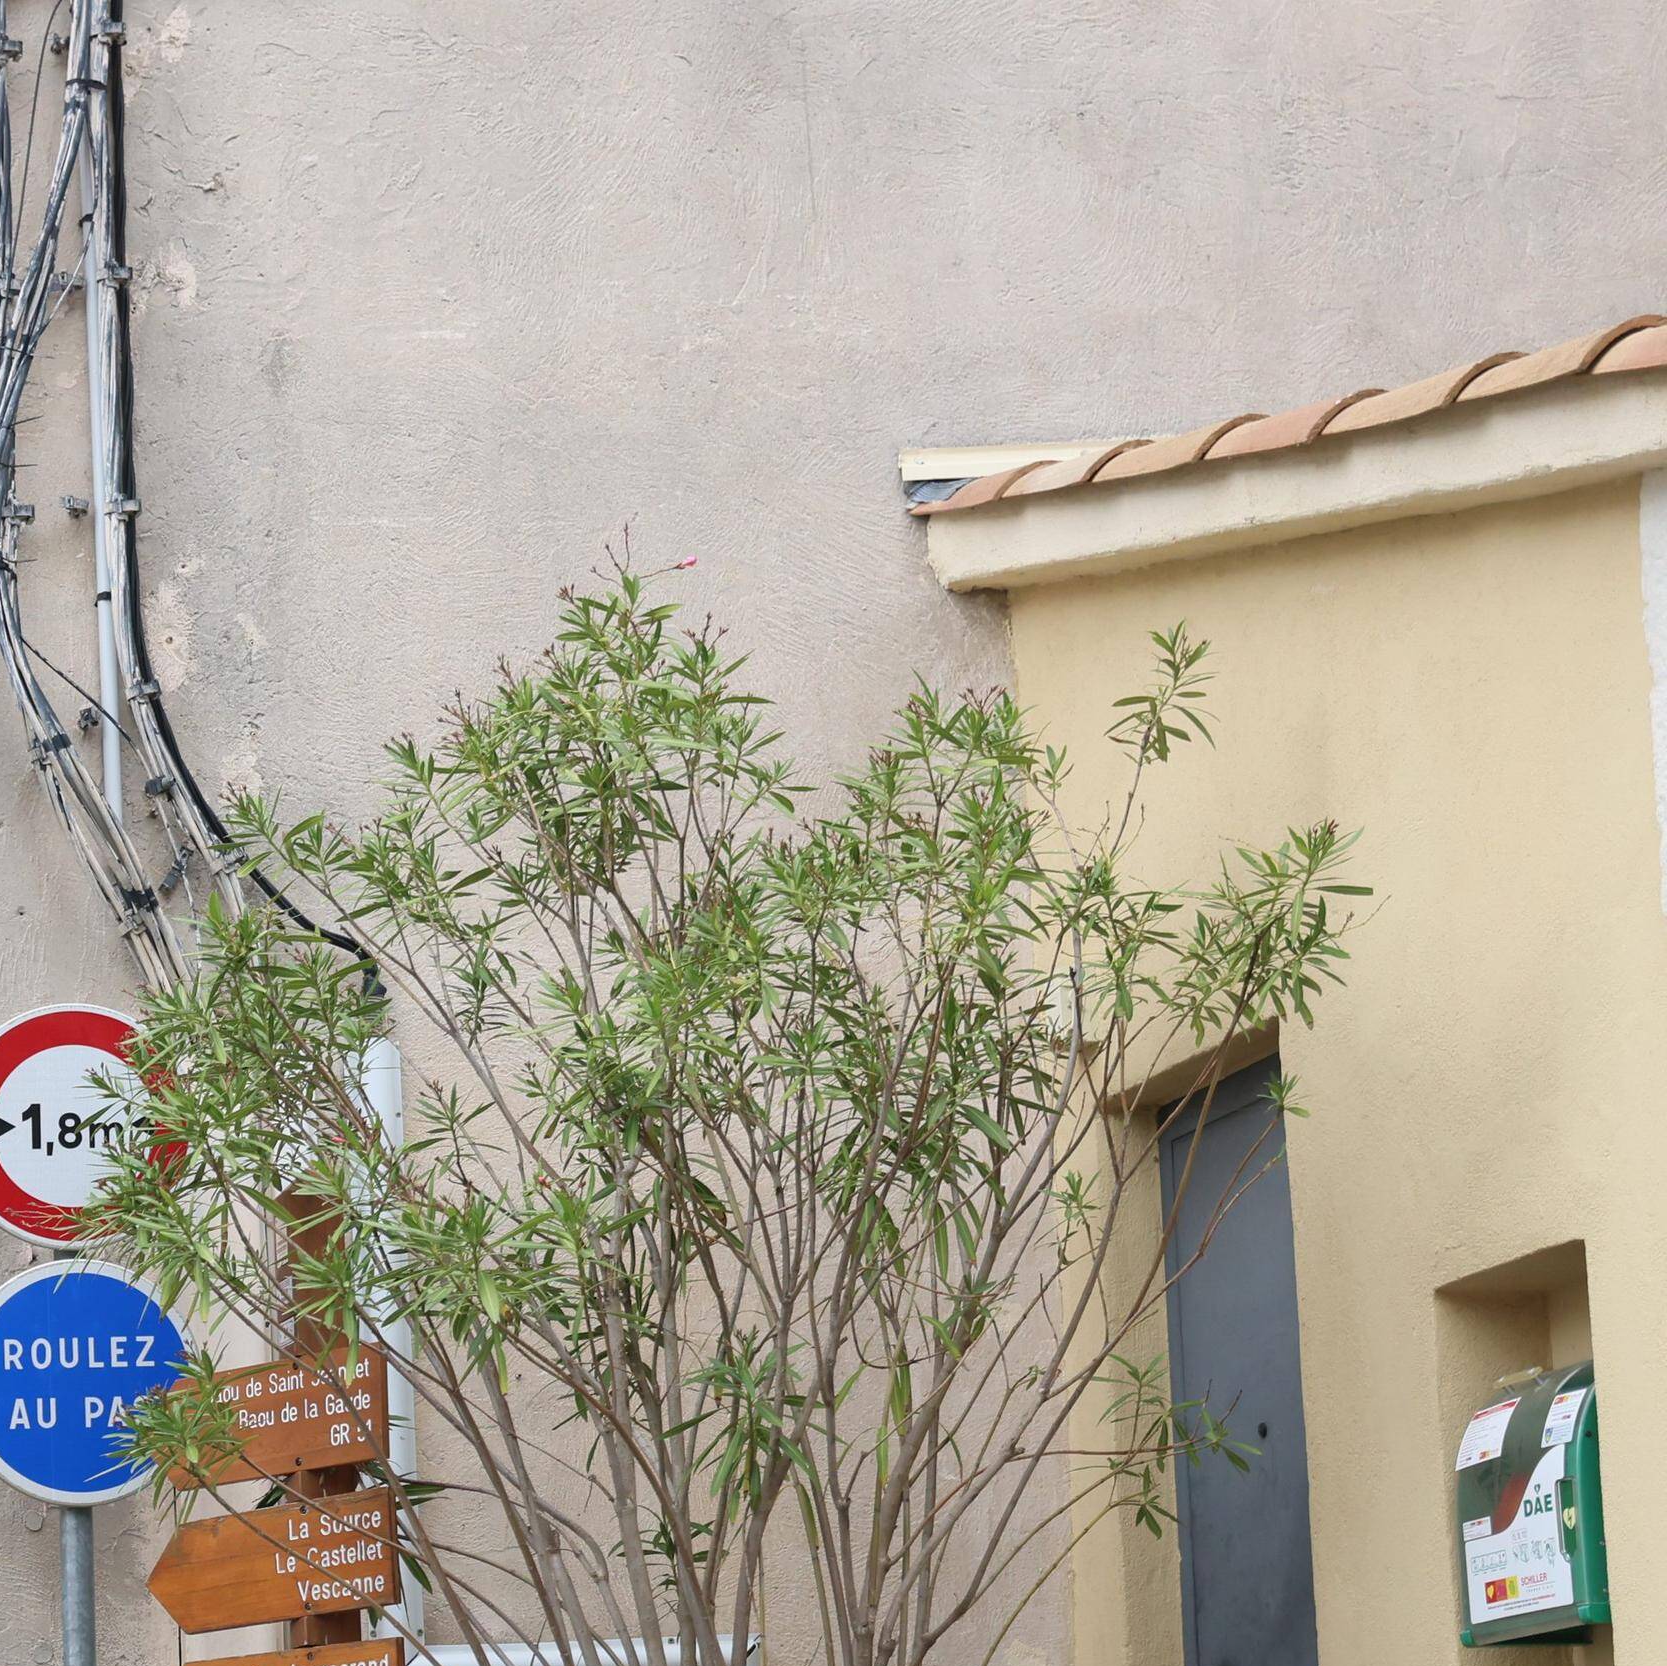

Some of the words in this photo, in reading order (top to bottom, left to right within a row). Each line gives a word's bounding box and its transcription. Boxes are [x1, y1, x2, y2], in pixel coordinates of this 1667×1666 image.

[3, 1335, 156, 1370] ROULEZ
[245, 1377, 262, 1398] de
[269, 1369, 304, 1394] Saint
[9, 1397, 57, 1430] AU
[239, 1409, 275, 1429] Baou
[281, 1401, 298, 1423] de
[304, 1398, 319, 1419] la
[330, 1423, 350, 1446] GR
[1523, 1493, 1553, 1517] DAE
[288, 1518, 309, 1541] La
[319, 1510, 382, 1536] Source
[275, 1552, 296, 1574] Le
[307, 1540, 383, 1569] Castellet
[297, 1574, 385, 1602] Vescagne
